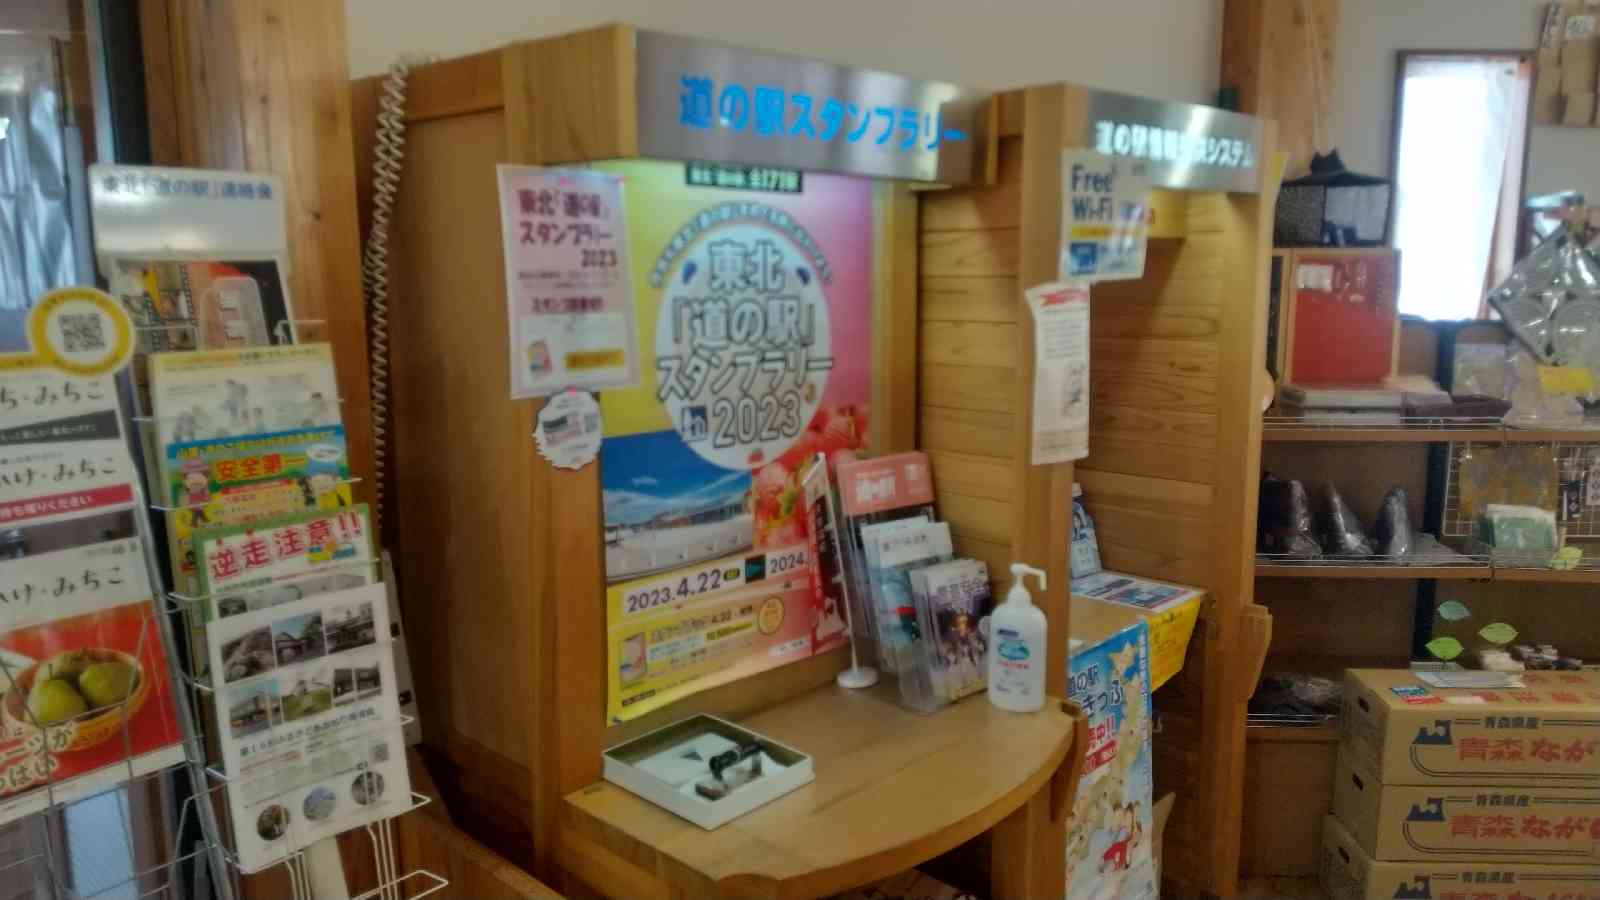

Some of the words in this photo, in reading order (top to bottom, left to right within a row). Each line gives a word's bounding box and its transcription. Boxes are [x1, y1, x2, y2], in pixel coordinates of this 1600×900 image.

[678, 75, 968, 151] 道の駅スタンプラリー
[1071, 164, 1113, 192] Free
[1071, 197, 1113, 221] Wi-Fi
[580, 247, 618, 269] 2023
[707, 238, 786, 294] 東北
[671, 294, 817, 351] 「道の駅」
[657, 350, 835, 402] スタンプラリー
[712, 389, 802, 449] 2023
[626, 568, 722, 614] 2023.4.22
